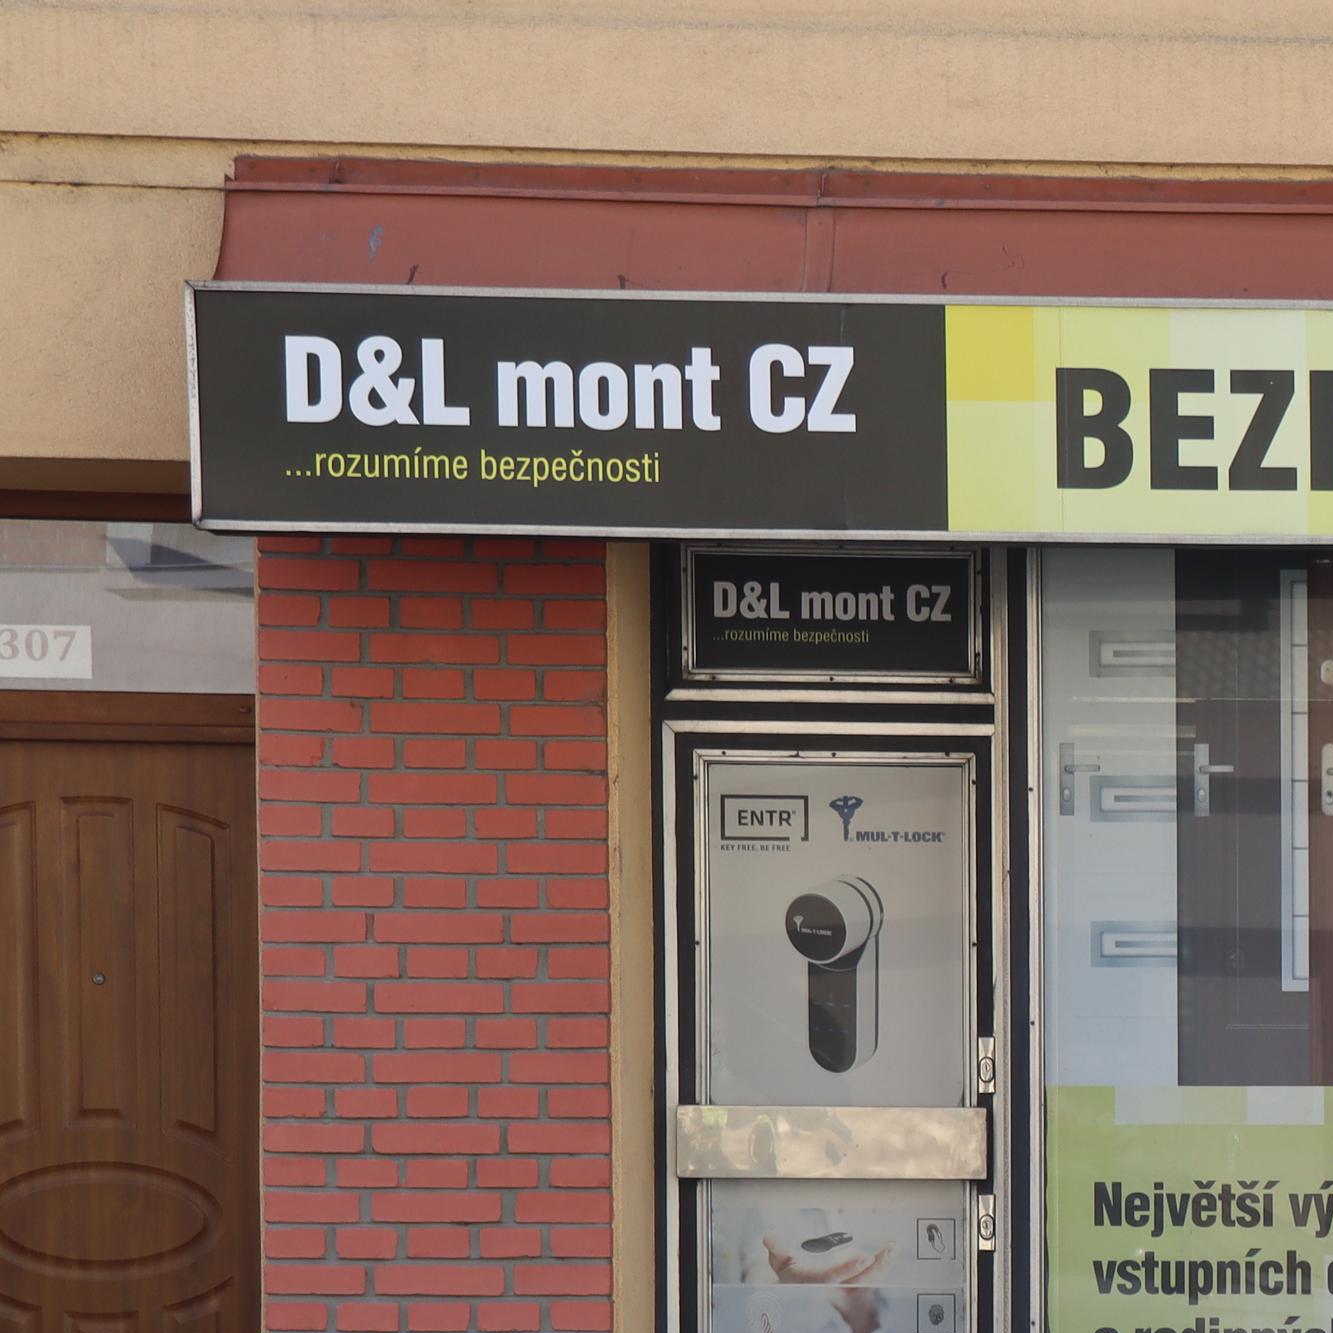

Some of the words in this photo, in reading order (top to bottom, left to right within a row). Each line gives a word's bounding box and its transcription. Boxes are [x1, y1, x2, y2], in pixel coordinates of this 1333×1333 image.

[285, 334, 470, 426] D&L
[498, 346, 721, 432] mont
[749, 343, 857, 433] CZ
[285, 449, 469, 481] ...rozumíme
[480, 450, 661, 487] bezpečnosti
[713, 581, 790, 620] D&L
[801, 586, 895, 622] mont
[906, 584, 952, 622] CZ
[793, 628, 870, 645] bezpečnosti
[737, 810, 792, 828] ENTR
[1093, 1180, 1281, 1237] Největší
[1093, 1248, 1312, 1305] vstupních
